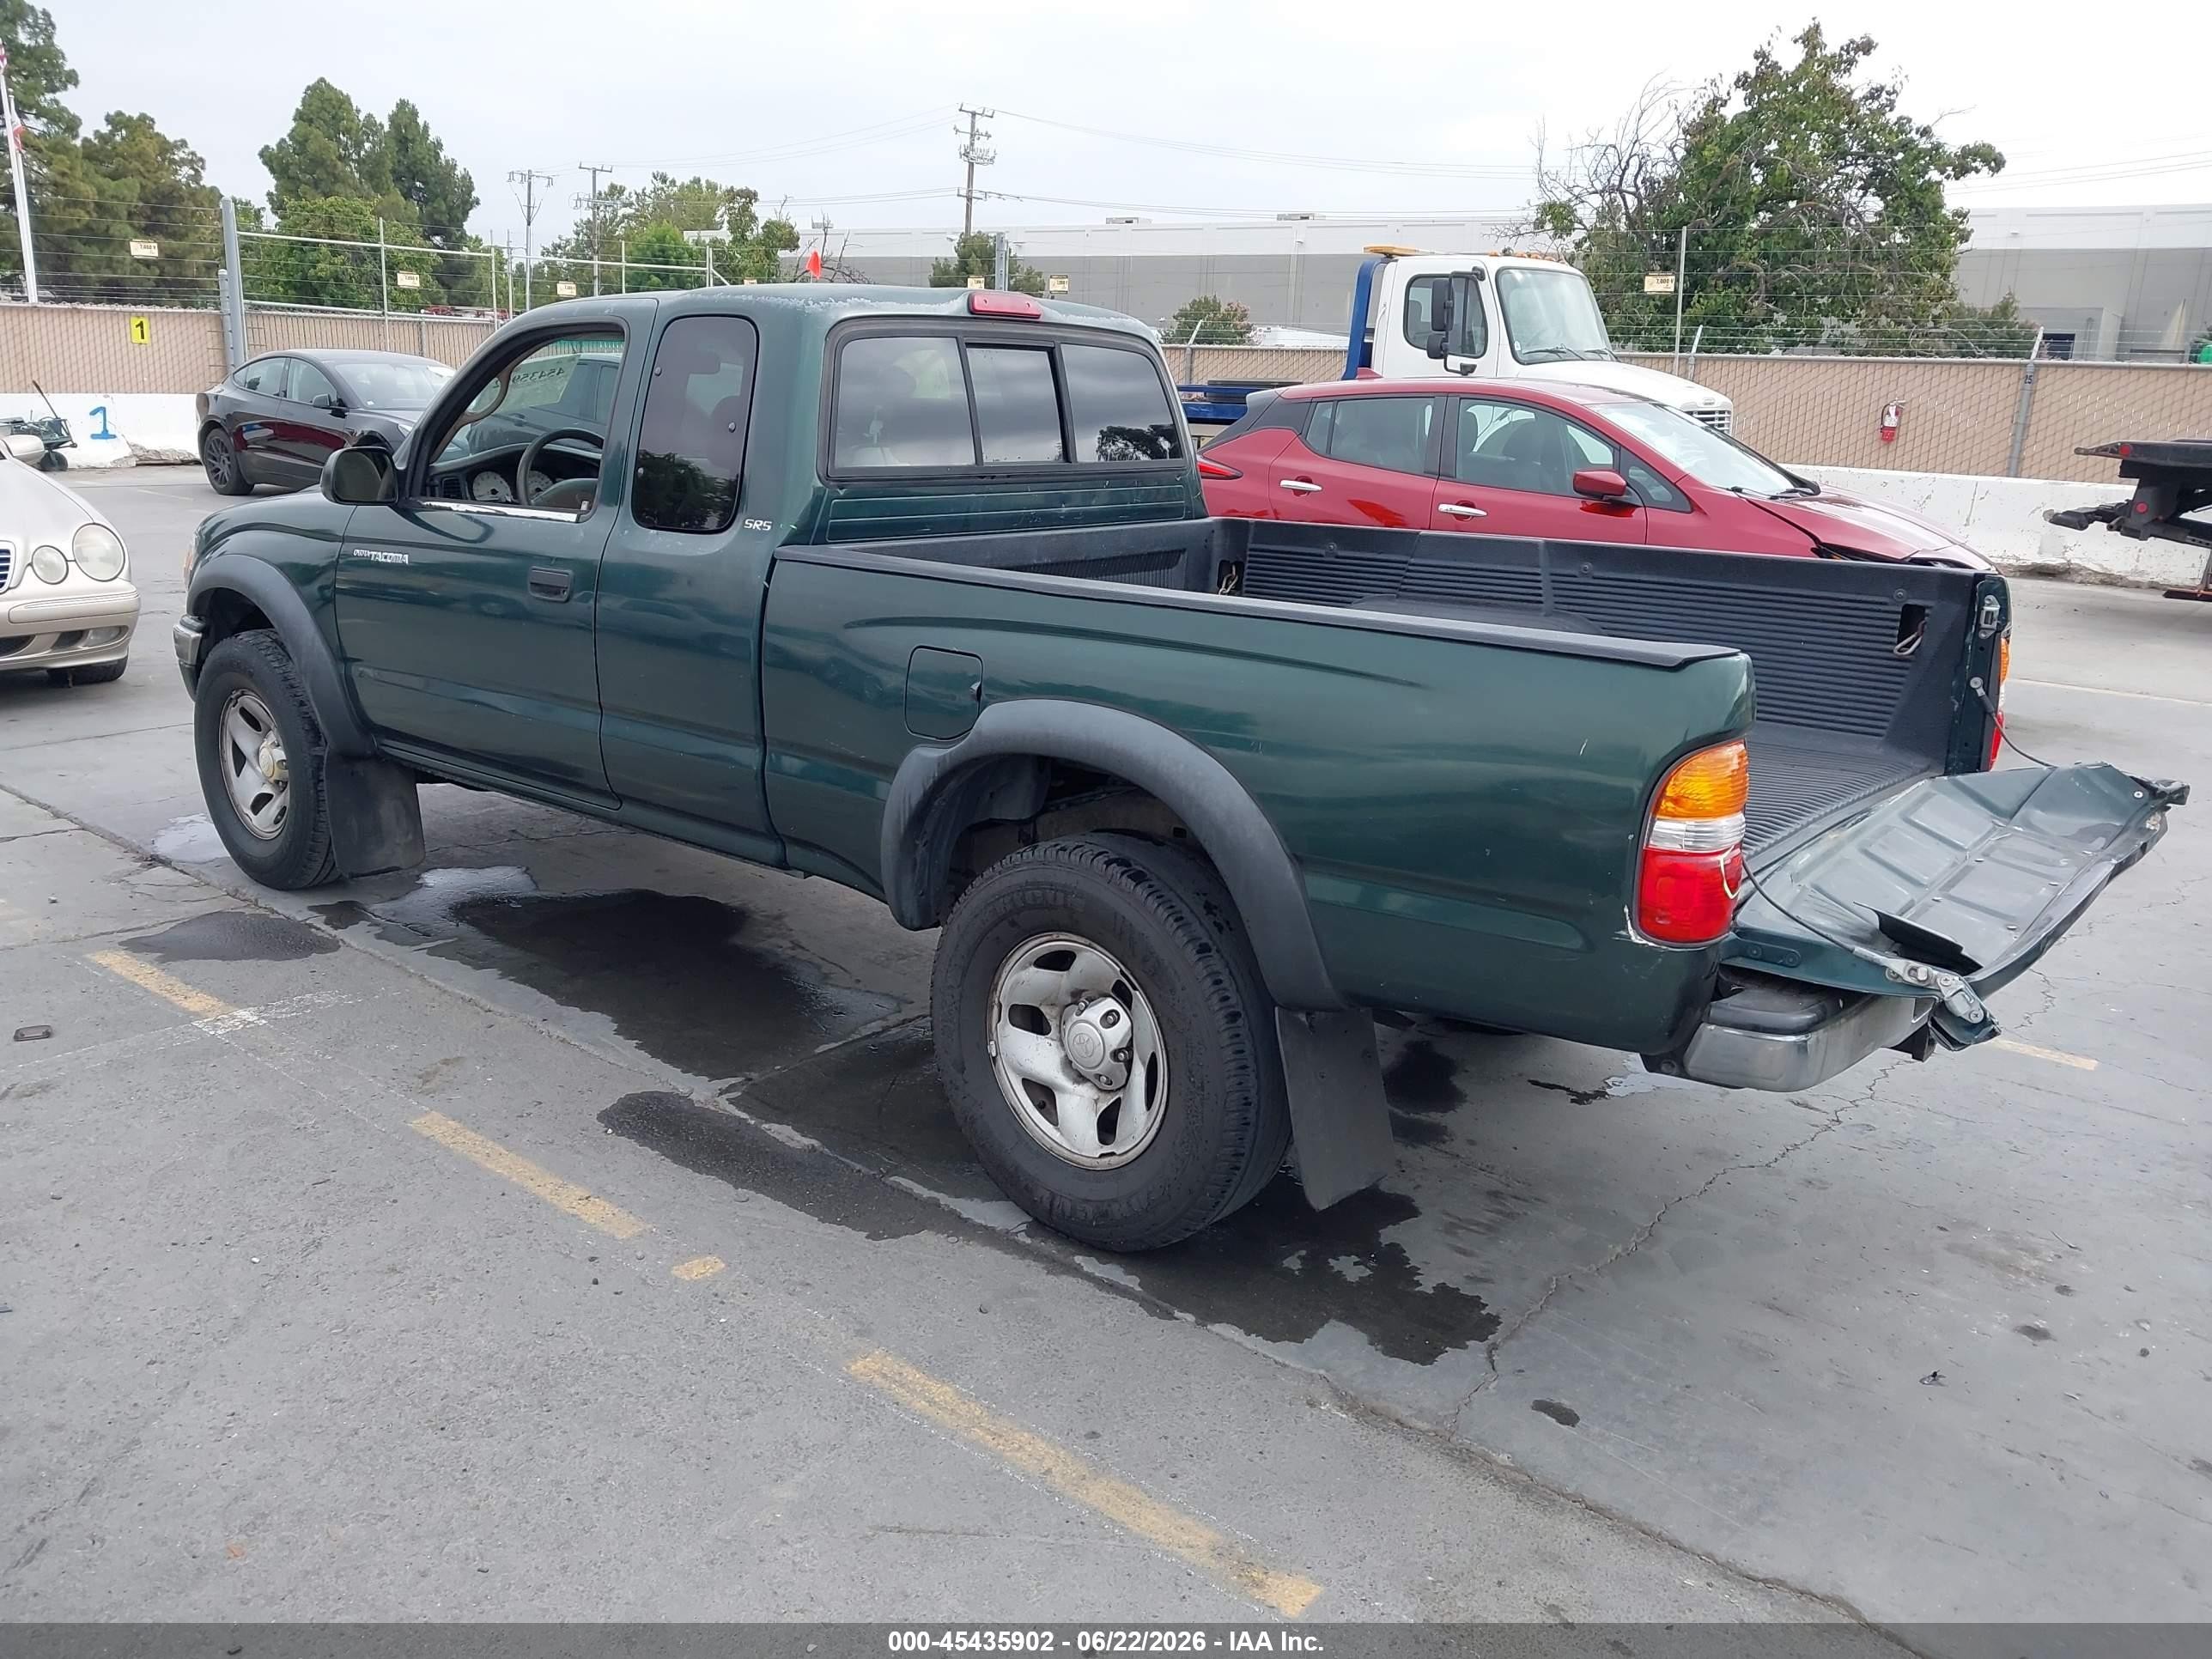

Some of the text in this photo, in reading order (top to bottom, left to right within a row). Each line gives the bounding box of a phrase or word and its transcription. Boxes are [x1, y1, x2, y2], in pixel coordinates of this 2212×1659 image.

[135, 320, 145, 340] 1
[88, 405, 118, 440] 1
[744, 518, 773, 532] SRS
[370, 551, 410, 565] TACOMA
